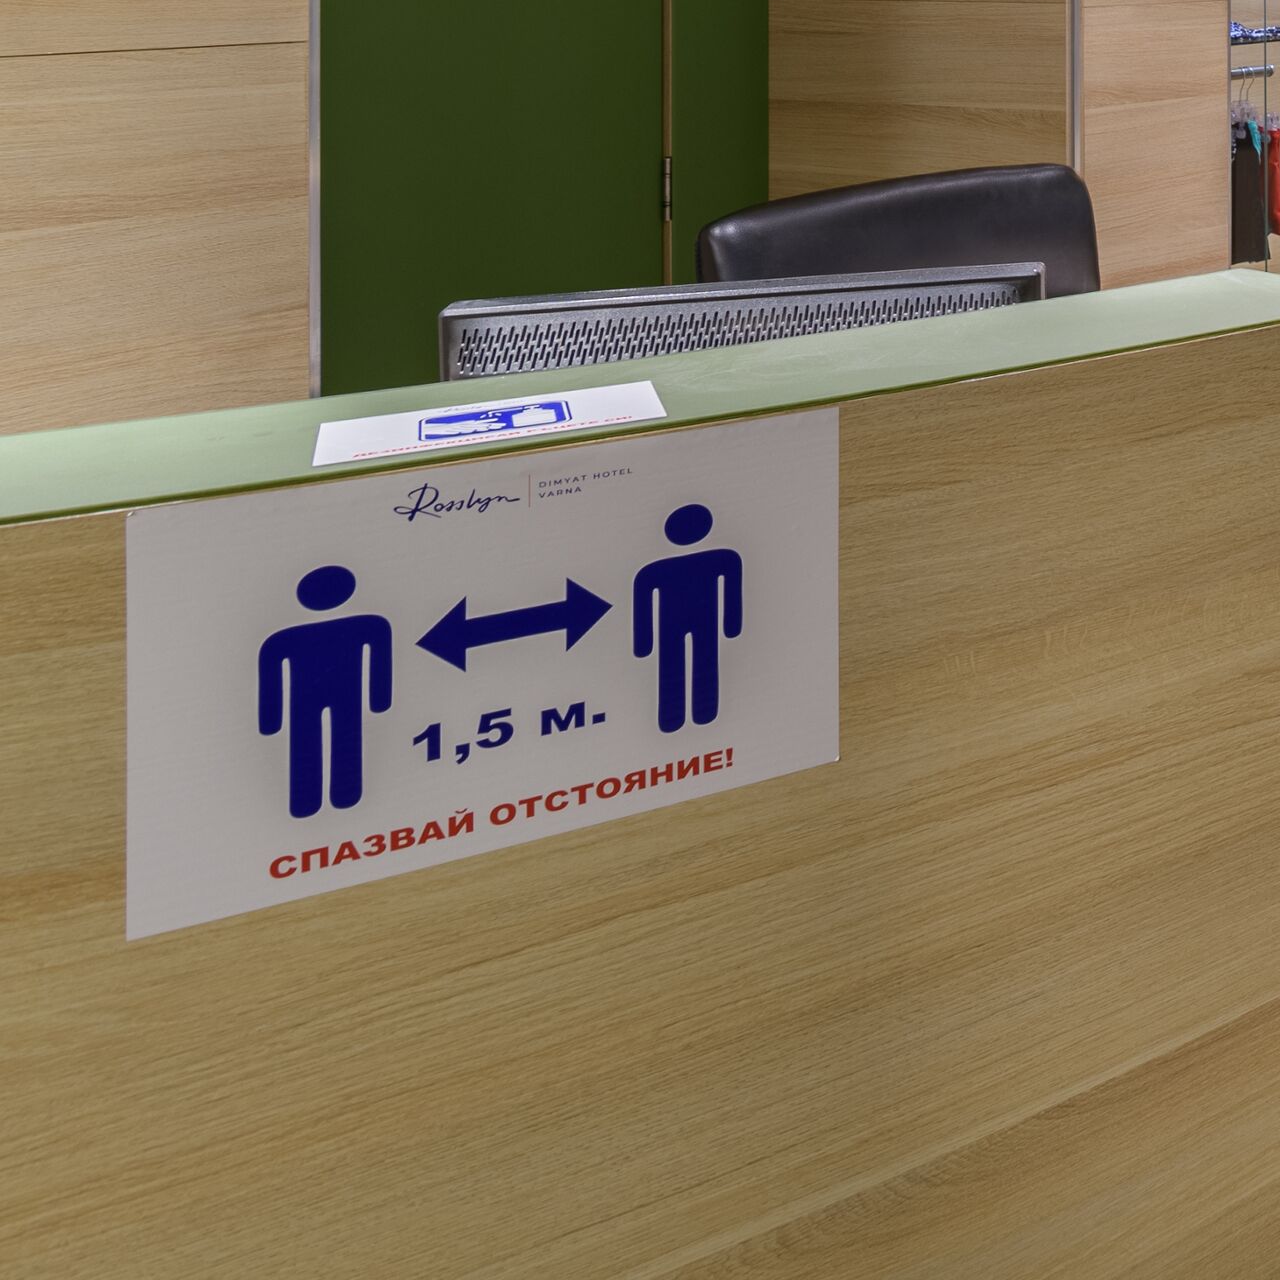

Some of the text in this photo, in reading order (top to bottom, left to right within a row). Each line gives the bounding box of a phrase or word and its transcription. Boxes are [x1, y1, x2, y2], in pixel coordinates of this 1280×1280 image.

[538, 486, 582, 499] VARNA
[539, 468, 633, 489] DIMYAT HOTEL
[393, 483, 520, 521] Rosslyn
[412, 701, 607, 765] 1,5 м.
[268, 747, 735, 880] СПАЗВАЙ ОТСТОЯНИЕ!
